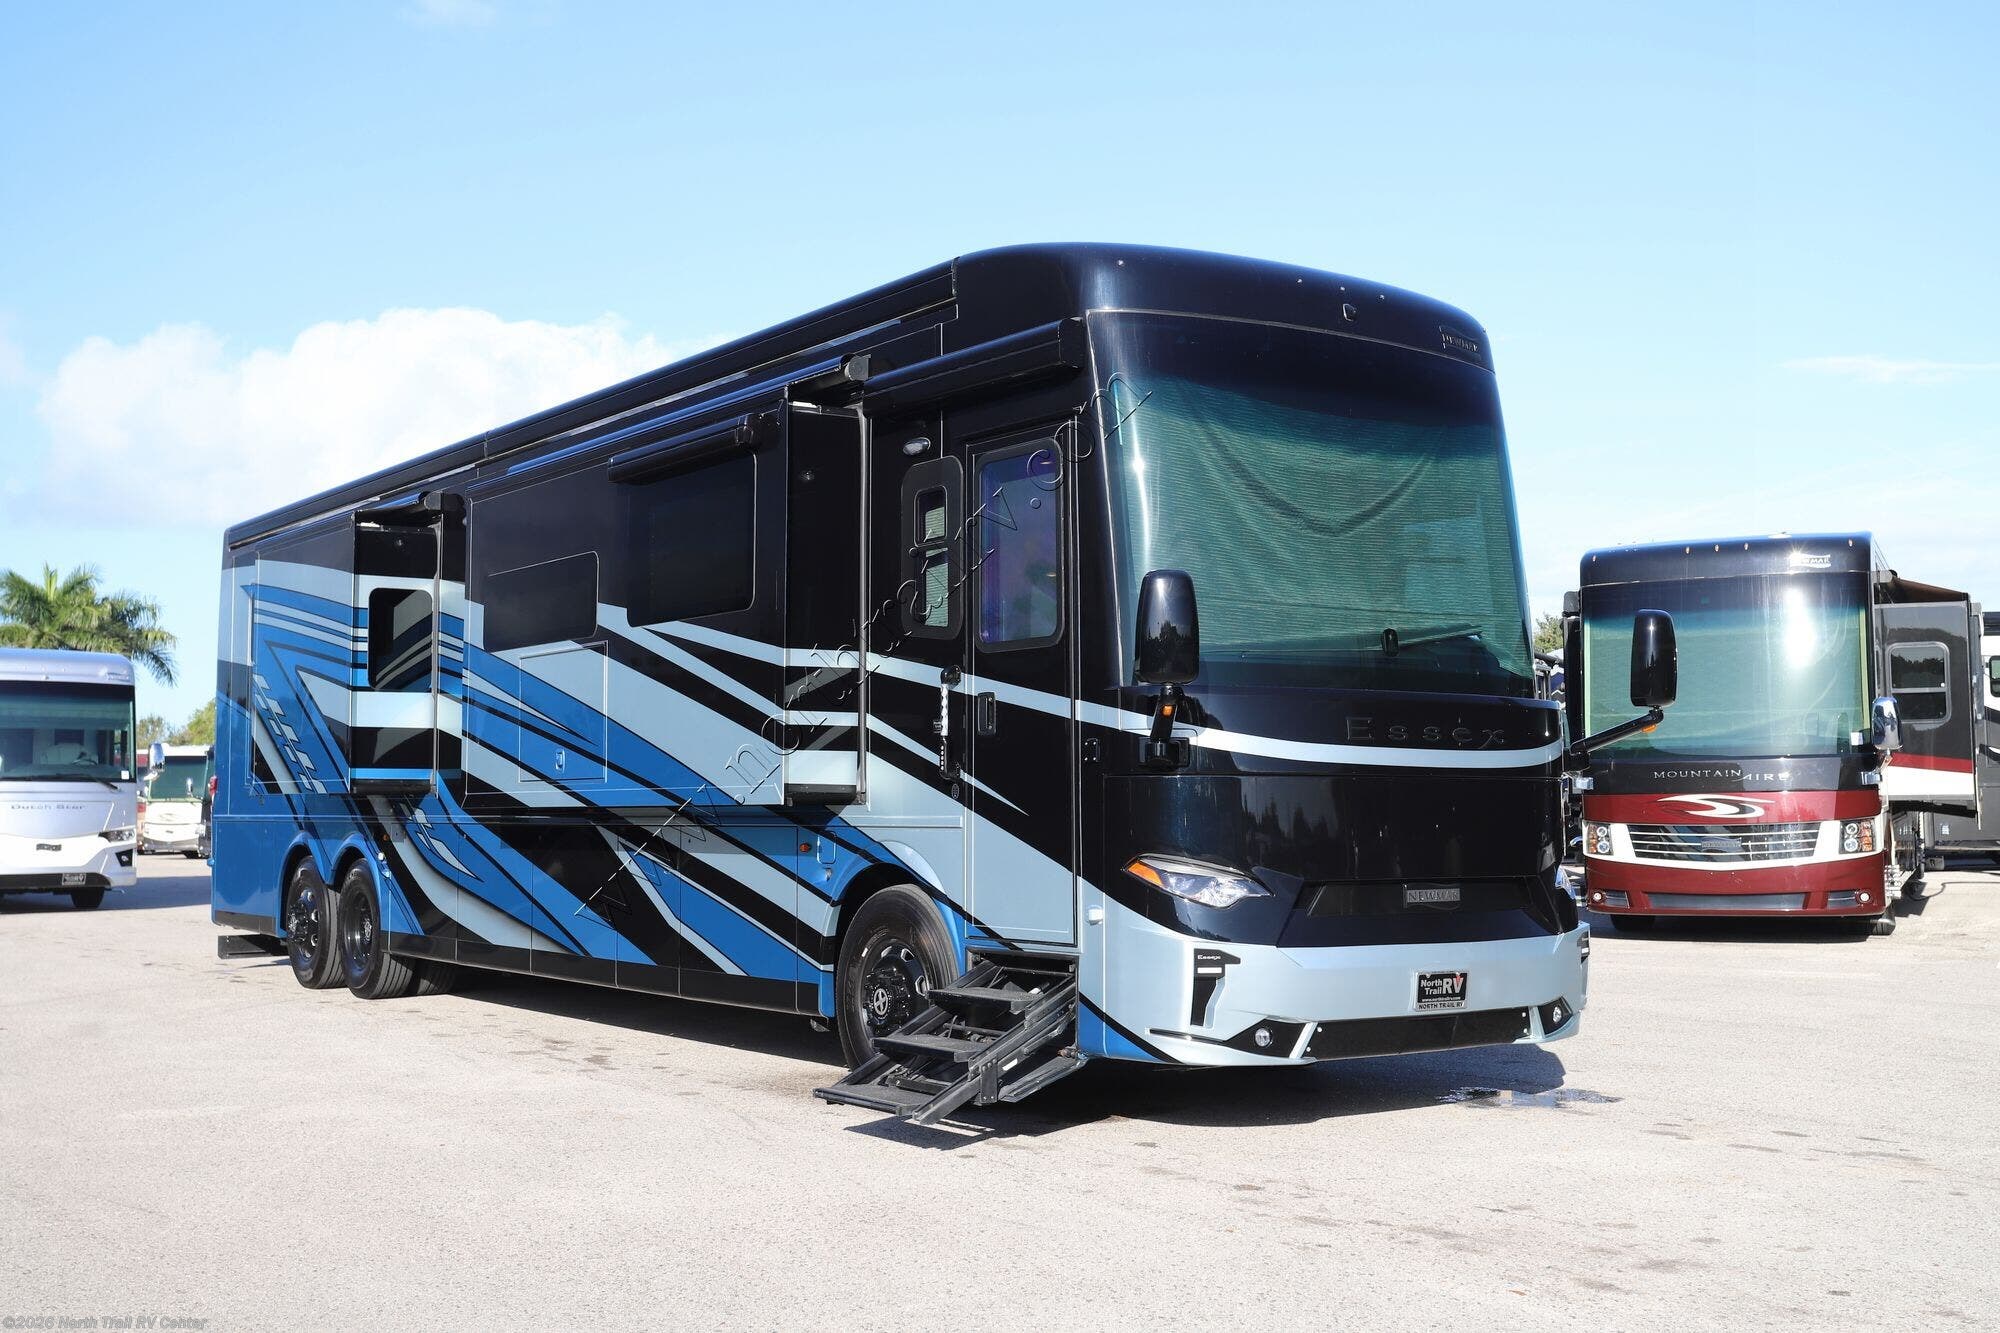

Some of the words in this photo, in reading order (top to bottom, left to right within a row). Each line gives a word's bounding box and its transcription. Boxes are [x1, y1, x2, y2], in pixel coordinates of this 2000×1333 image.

[1345, 716, 1505, 750] Essex
[1653, 769, 1741, 779] MOUNTAIN
[1420, 978, 1442, 987] North
[1442, 977, 1464, 994] RV
[1424, 986, 1442, 995] Trail
